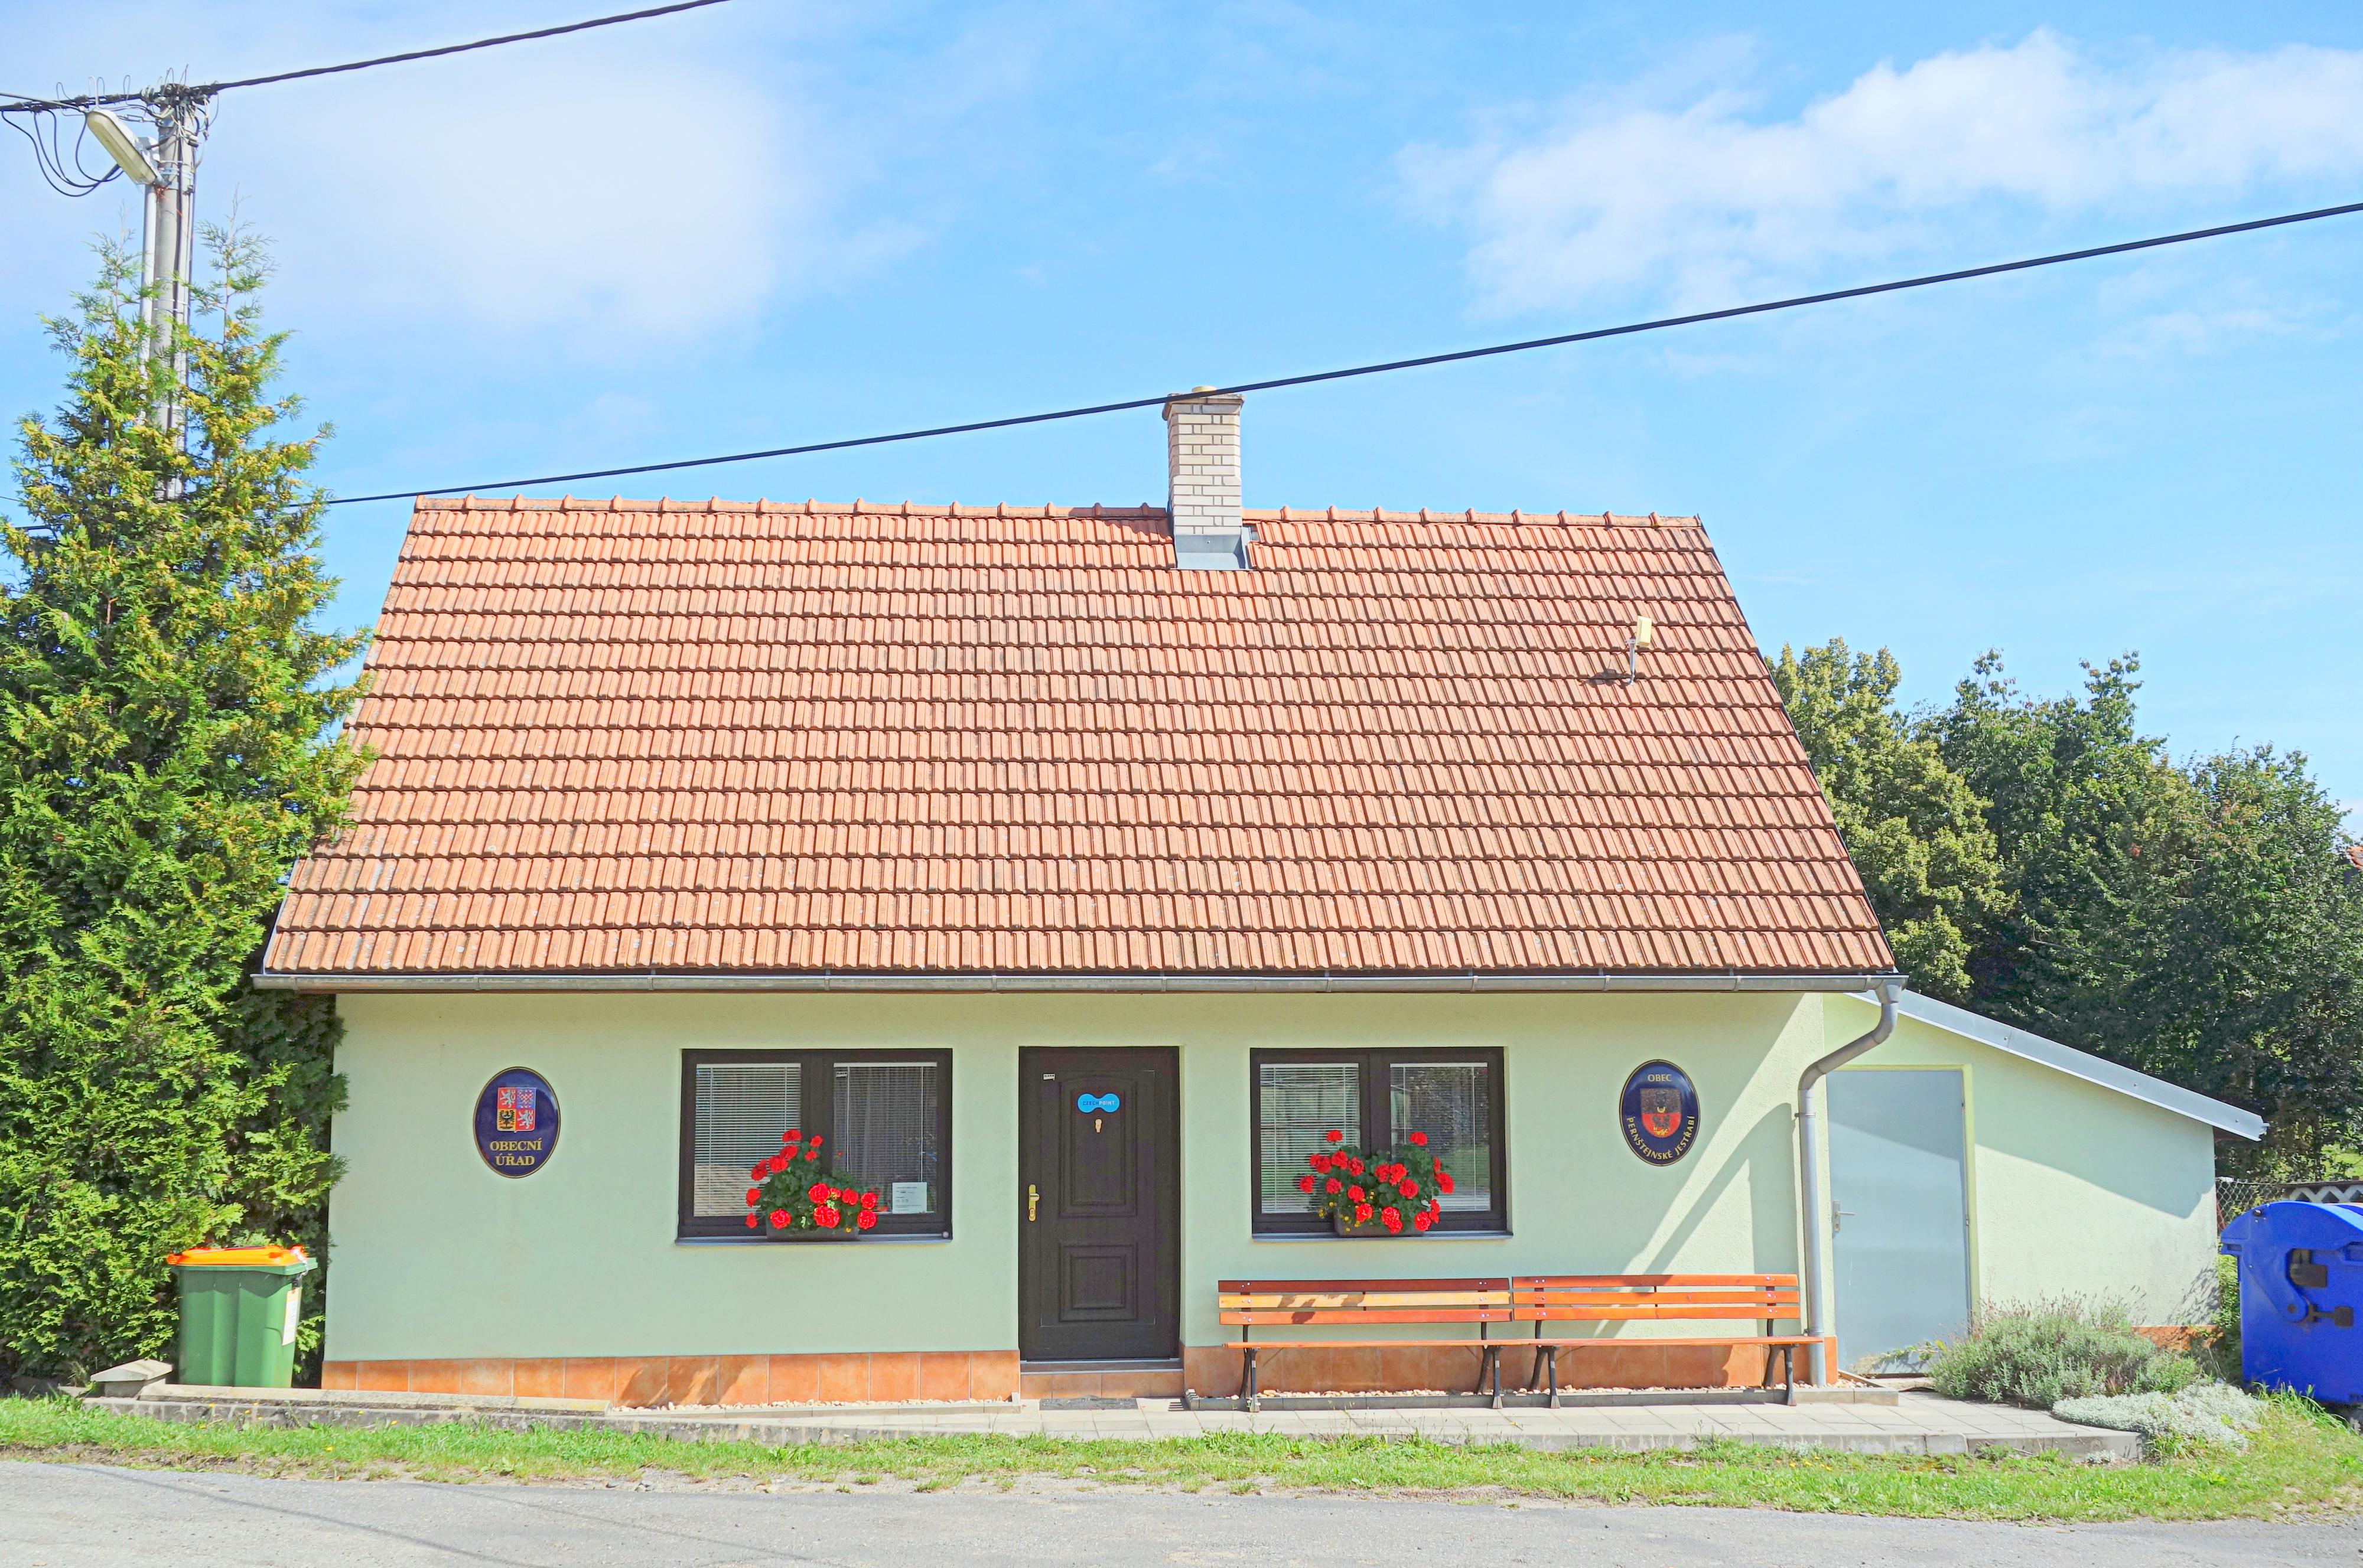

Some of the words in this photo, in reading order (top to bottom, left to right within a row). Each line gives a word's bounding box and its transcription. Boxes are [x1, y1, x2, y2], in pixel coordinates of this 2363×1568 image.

[490, 1137, 542, 1151] OBECNÍ
[1626, 1116, 1673, 1160] PERNŠTEJNSKÉ
[495, 1153, 535, 1166] ÚŘAD
